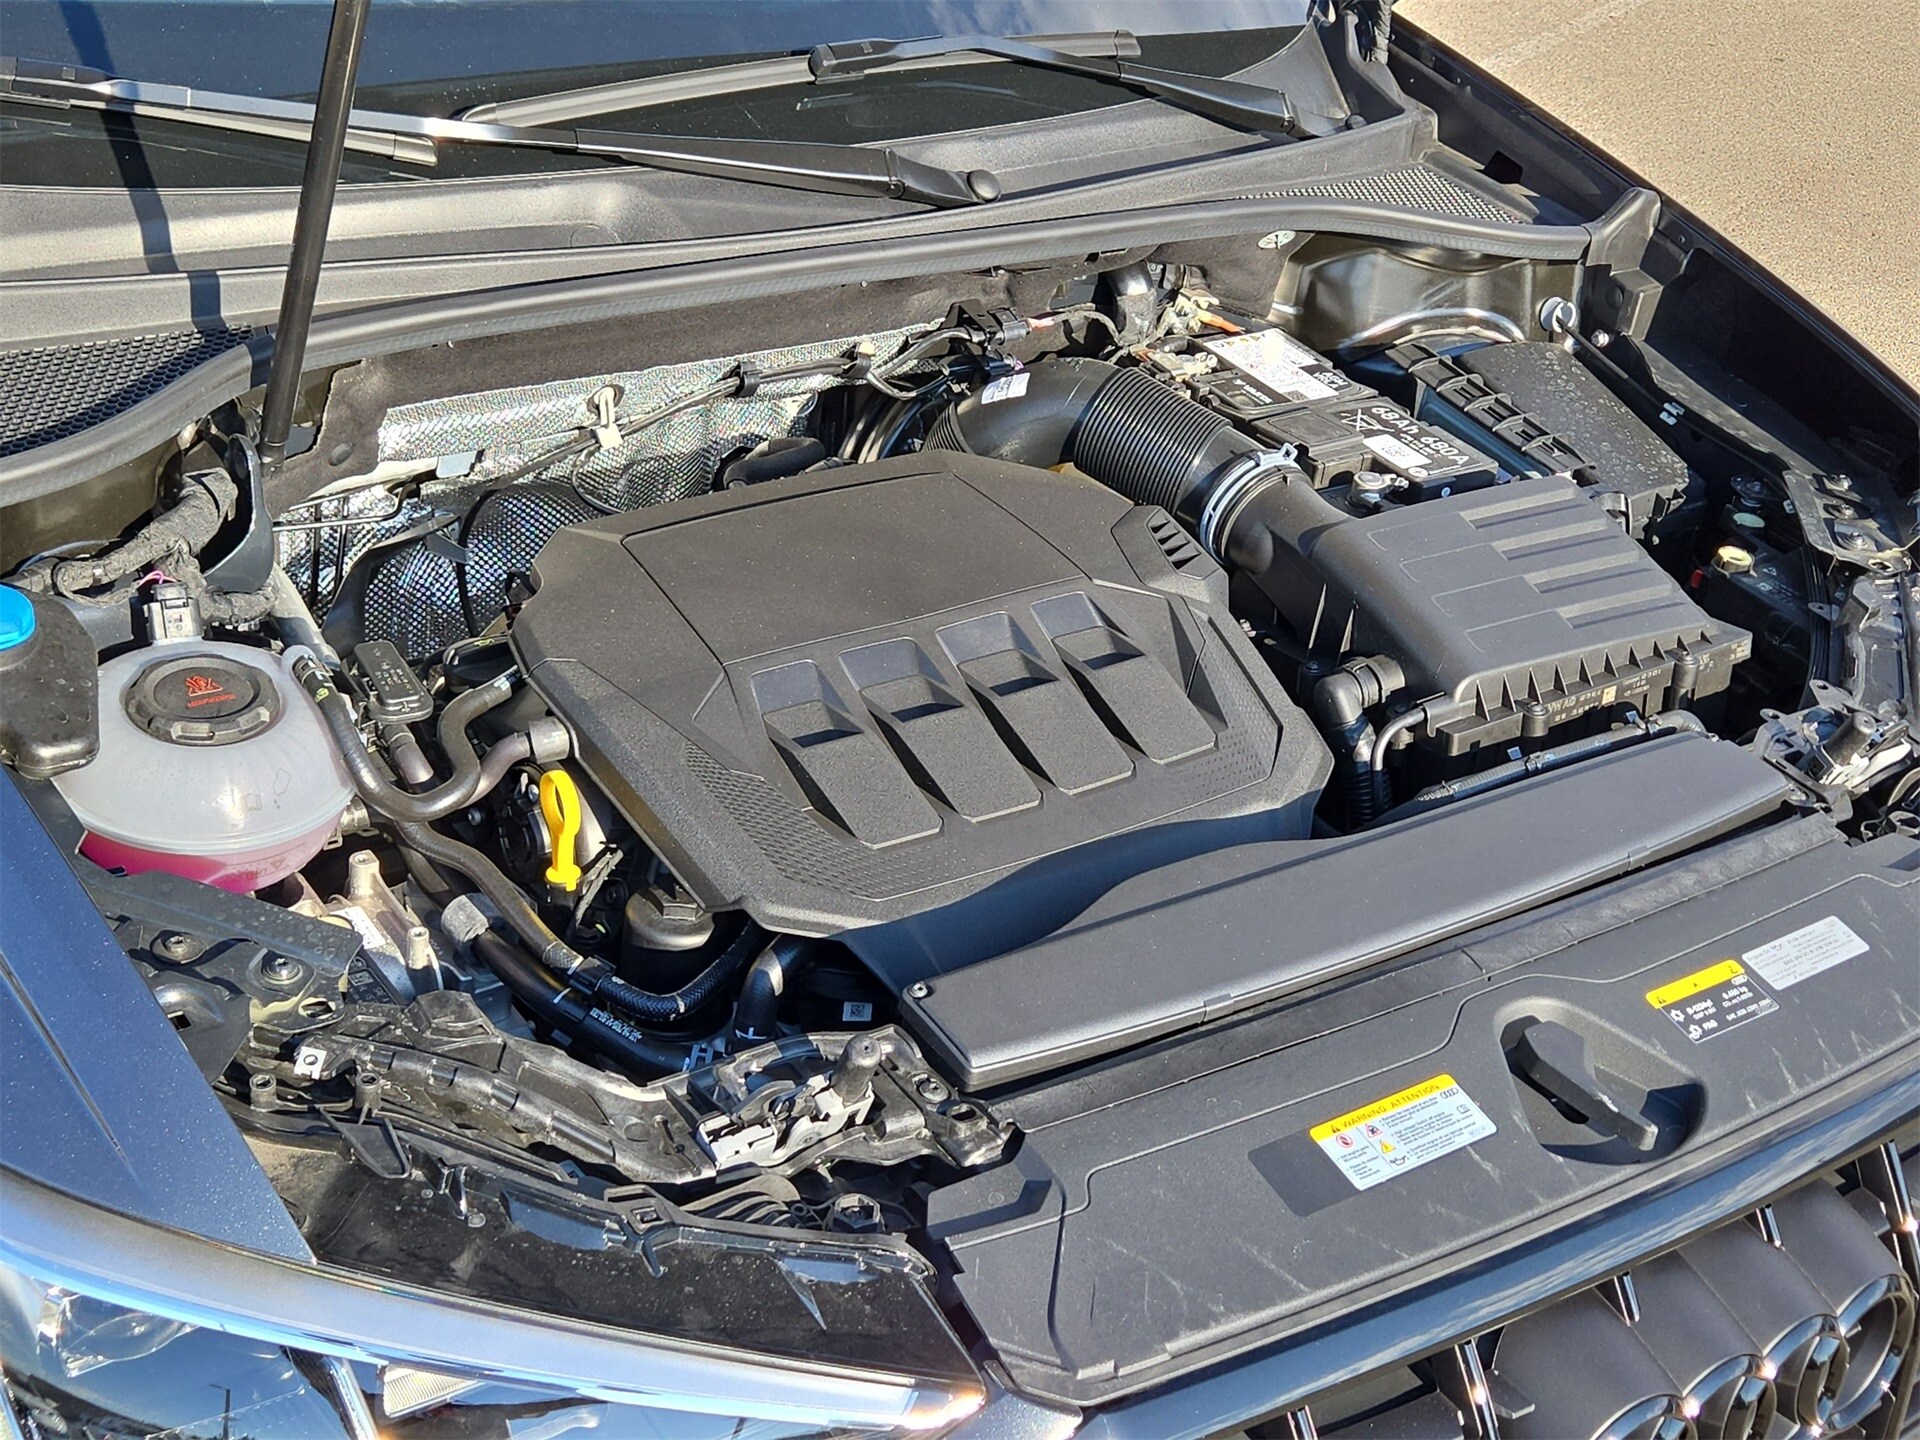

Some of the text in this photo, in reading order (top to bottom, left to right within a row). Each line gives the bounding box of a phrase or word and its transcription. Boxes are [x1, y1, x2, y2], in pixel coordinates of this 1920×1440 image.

[1371, 406, 1419, 434] 68Ah
[1420, 436, 1470, 465] 680A
[1343, 1105, 1387, 1128] WARNING
[1390, 1084, 1440, 1108] ATTENTION
